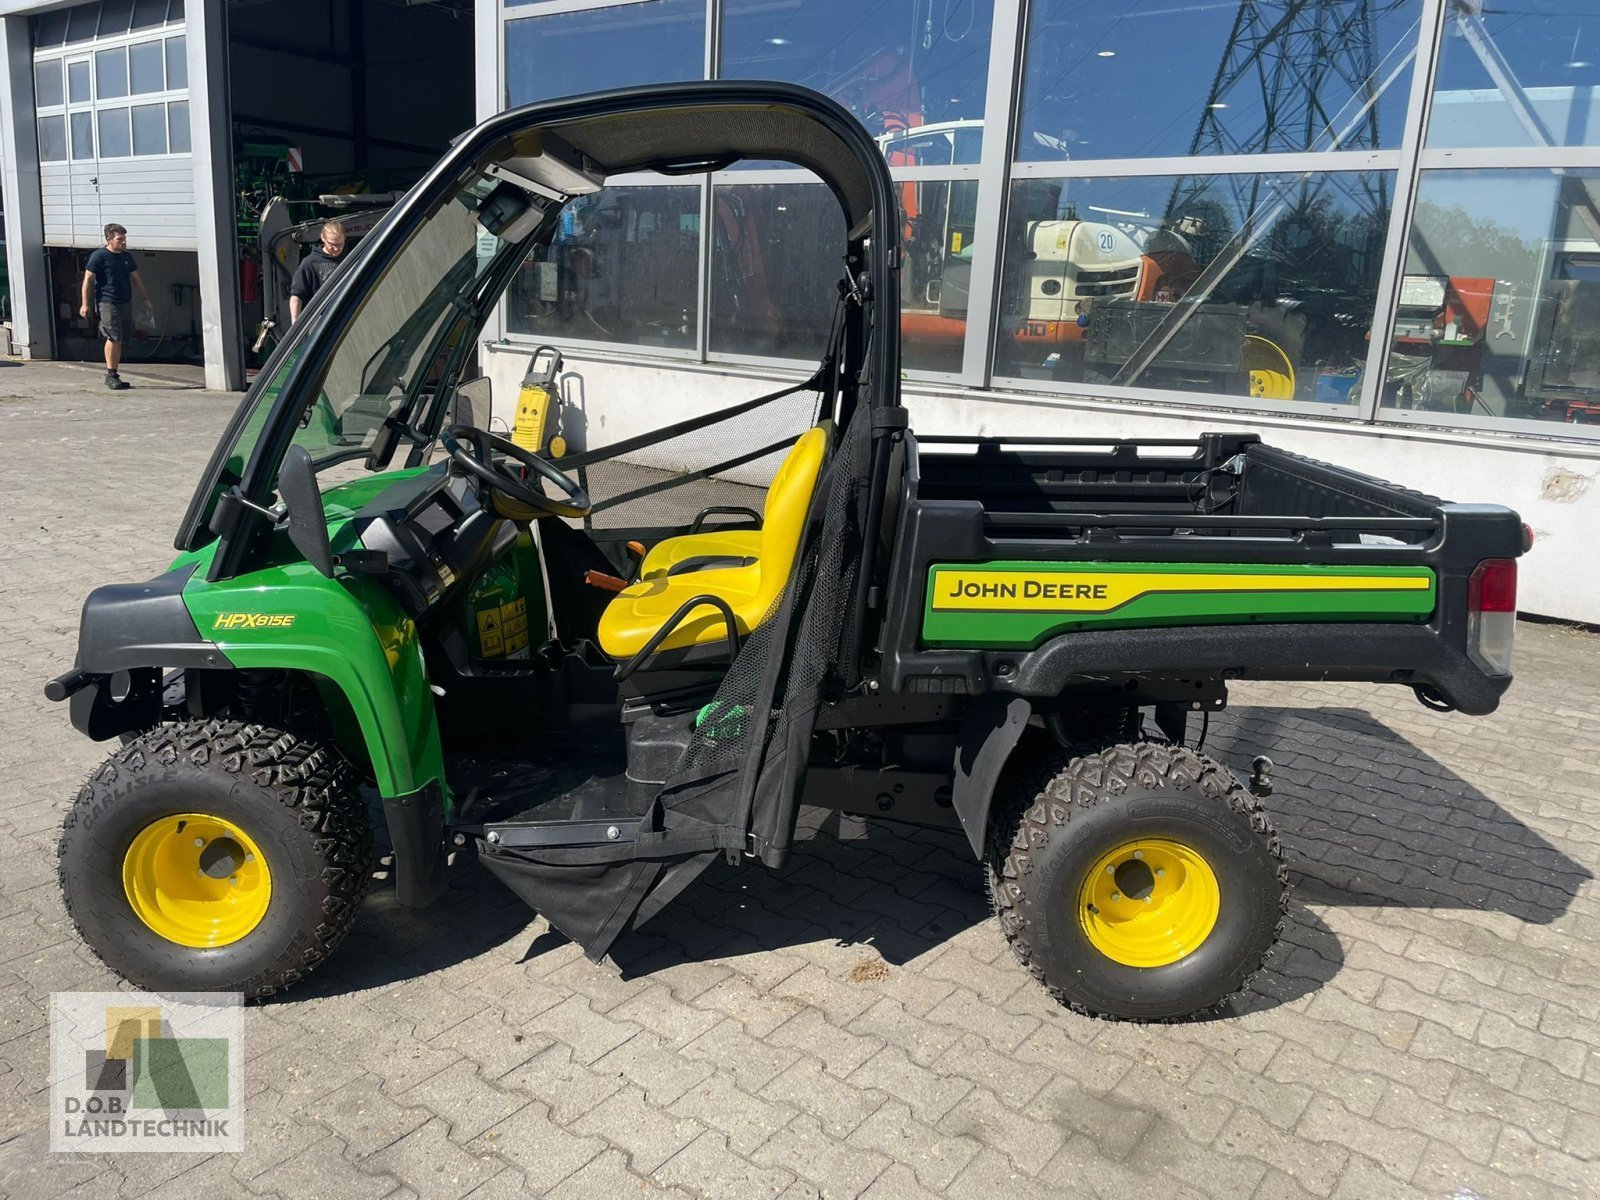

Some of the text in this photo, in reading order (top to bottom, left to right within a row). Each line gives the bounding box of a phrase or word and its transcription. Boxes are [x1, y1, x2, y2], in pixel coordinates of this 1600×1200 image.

[1100, 233, 1113, 249] 20
[949, 579, 1108, 599] JOHN DEERE
[213, 612, 296, 629] HPX815E
[83, 771, 178, 831] CARLISLE
